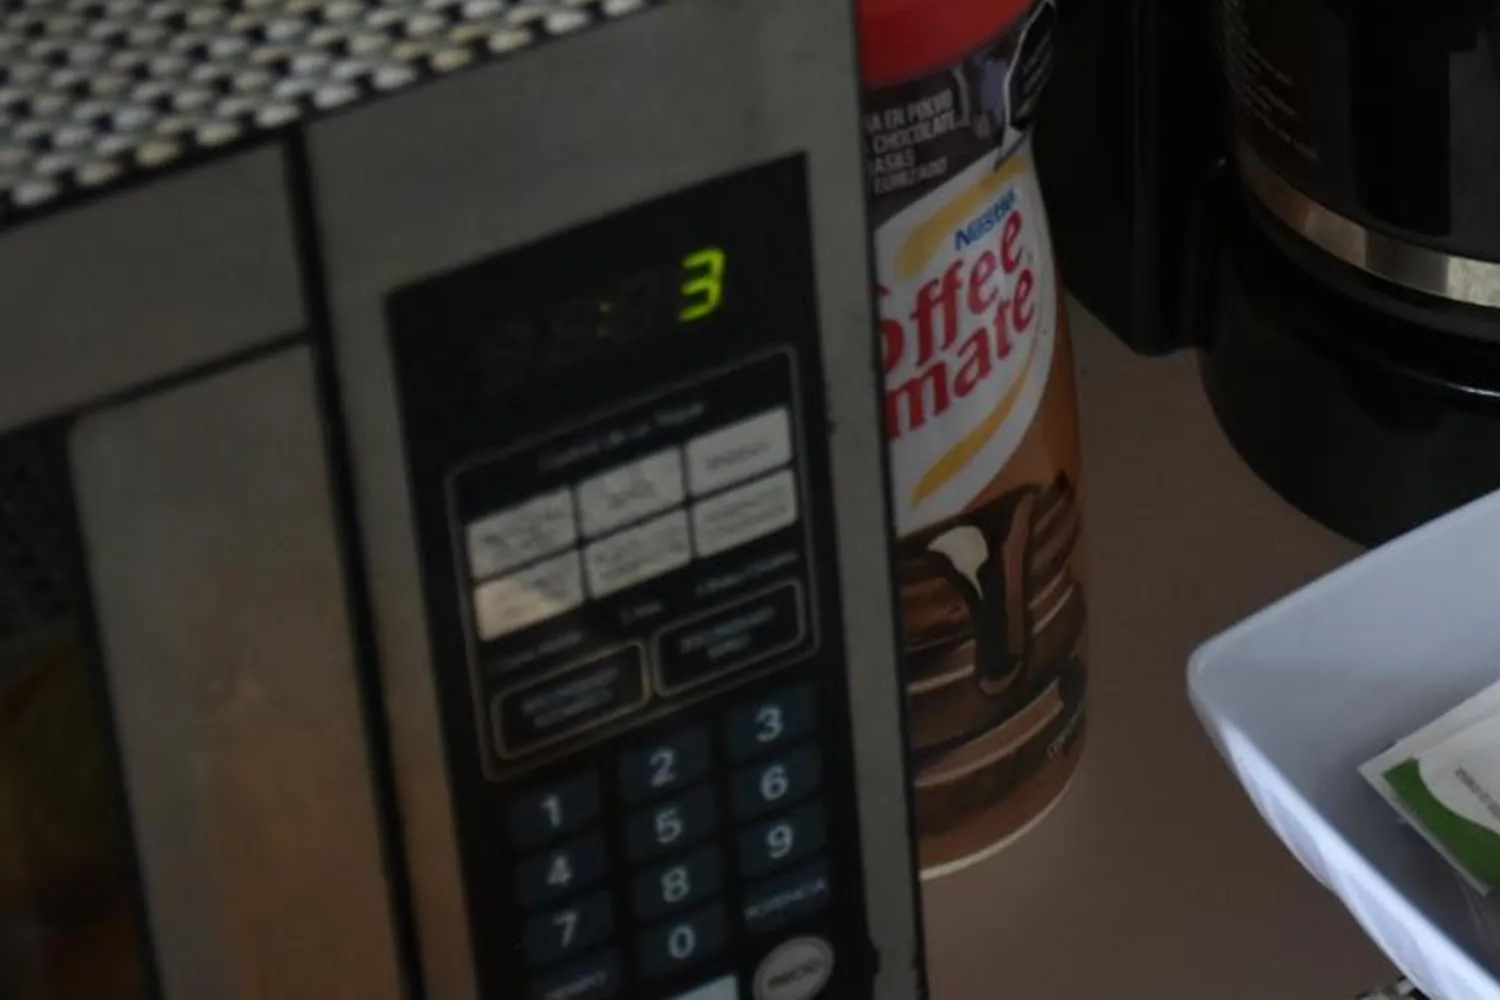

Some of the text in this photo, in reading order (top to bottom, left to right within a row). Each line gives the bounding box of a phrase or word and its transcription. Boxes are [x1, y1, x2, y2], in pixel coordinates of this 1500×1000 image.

[679, 245, 726, 323] 3
[873, 210, 1022, 377] offee
[884, 268, 1035, 440] mate
[754, 704, 784, 743] 3
[650, 746, 677, 788] 2
[760, 764, 789, 801] 6
[540, 793, 561, 829] 1
[654, 806, 683, 844] 5
[766, 823, 795, 860] 9
[546, 855, 574, 887] 4
[661, 866, 690, 903] 8
[553, 909, 579, 948] 7
[668, 924, 695, 959] 0
